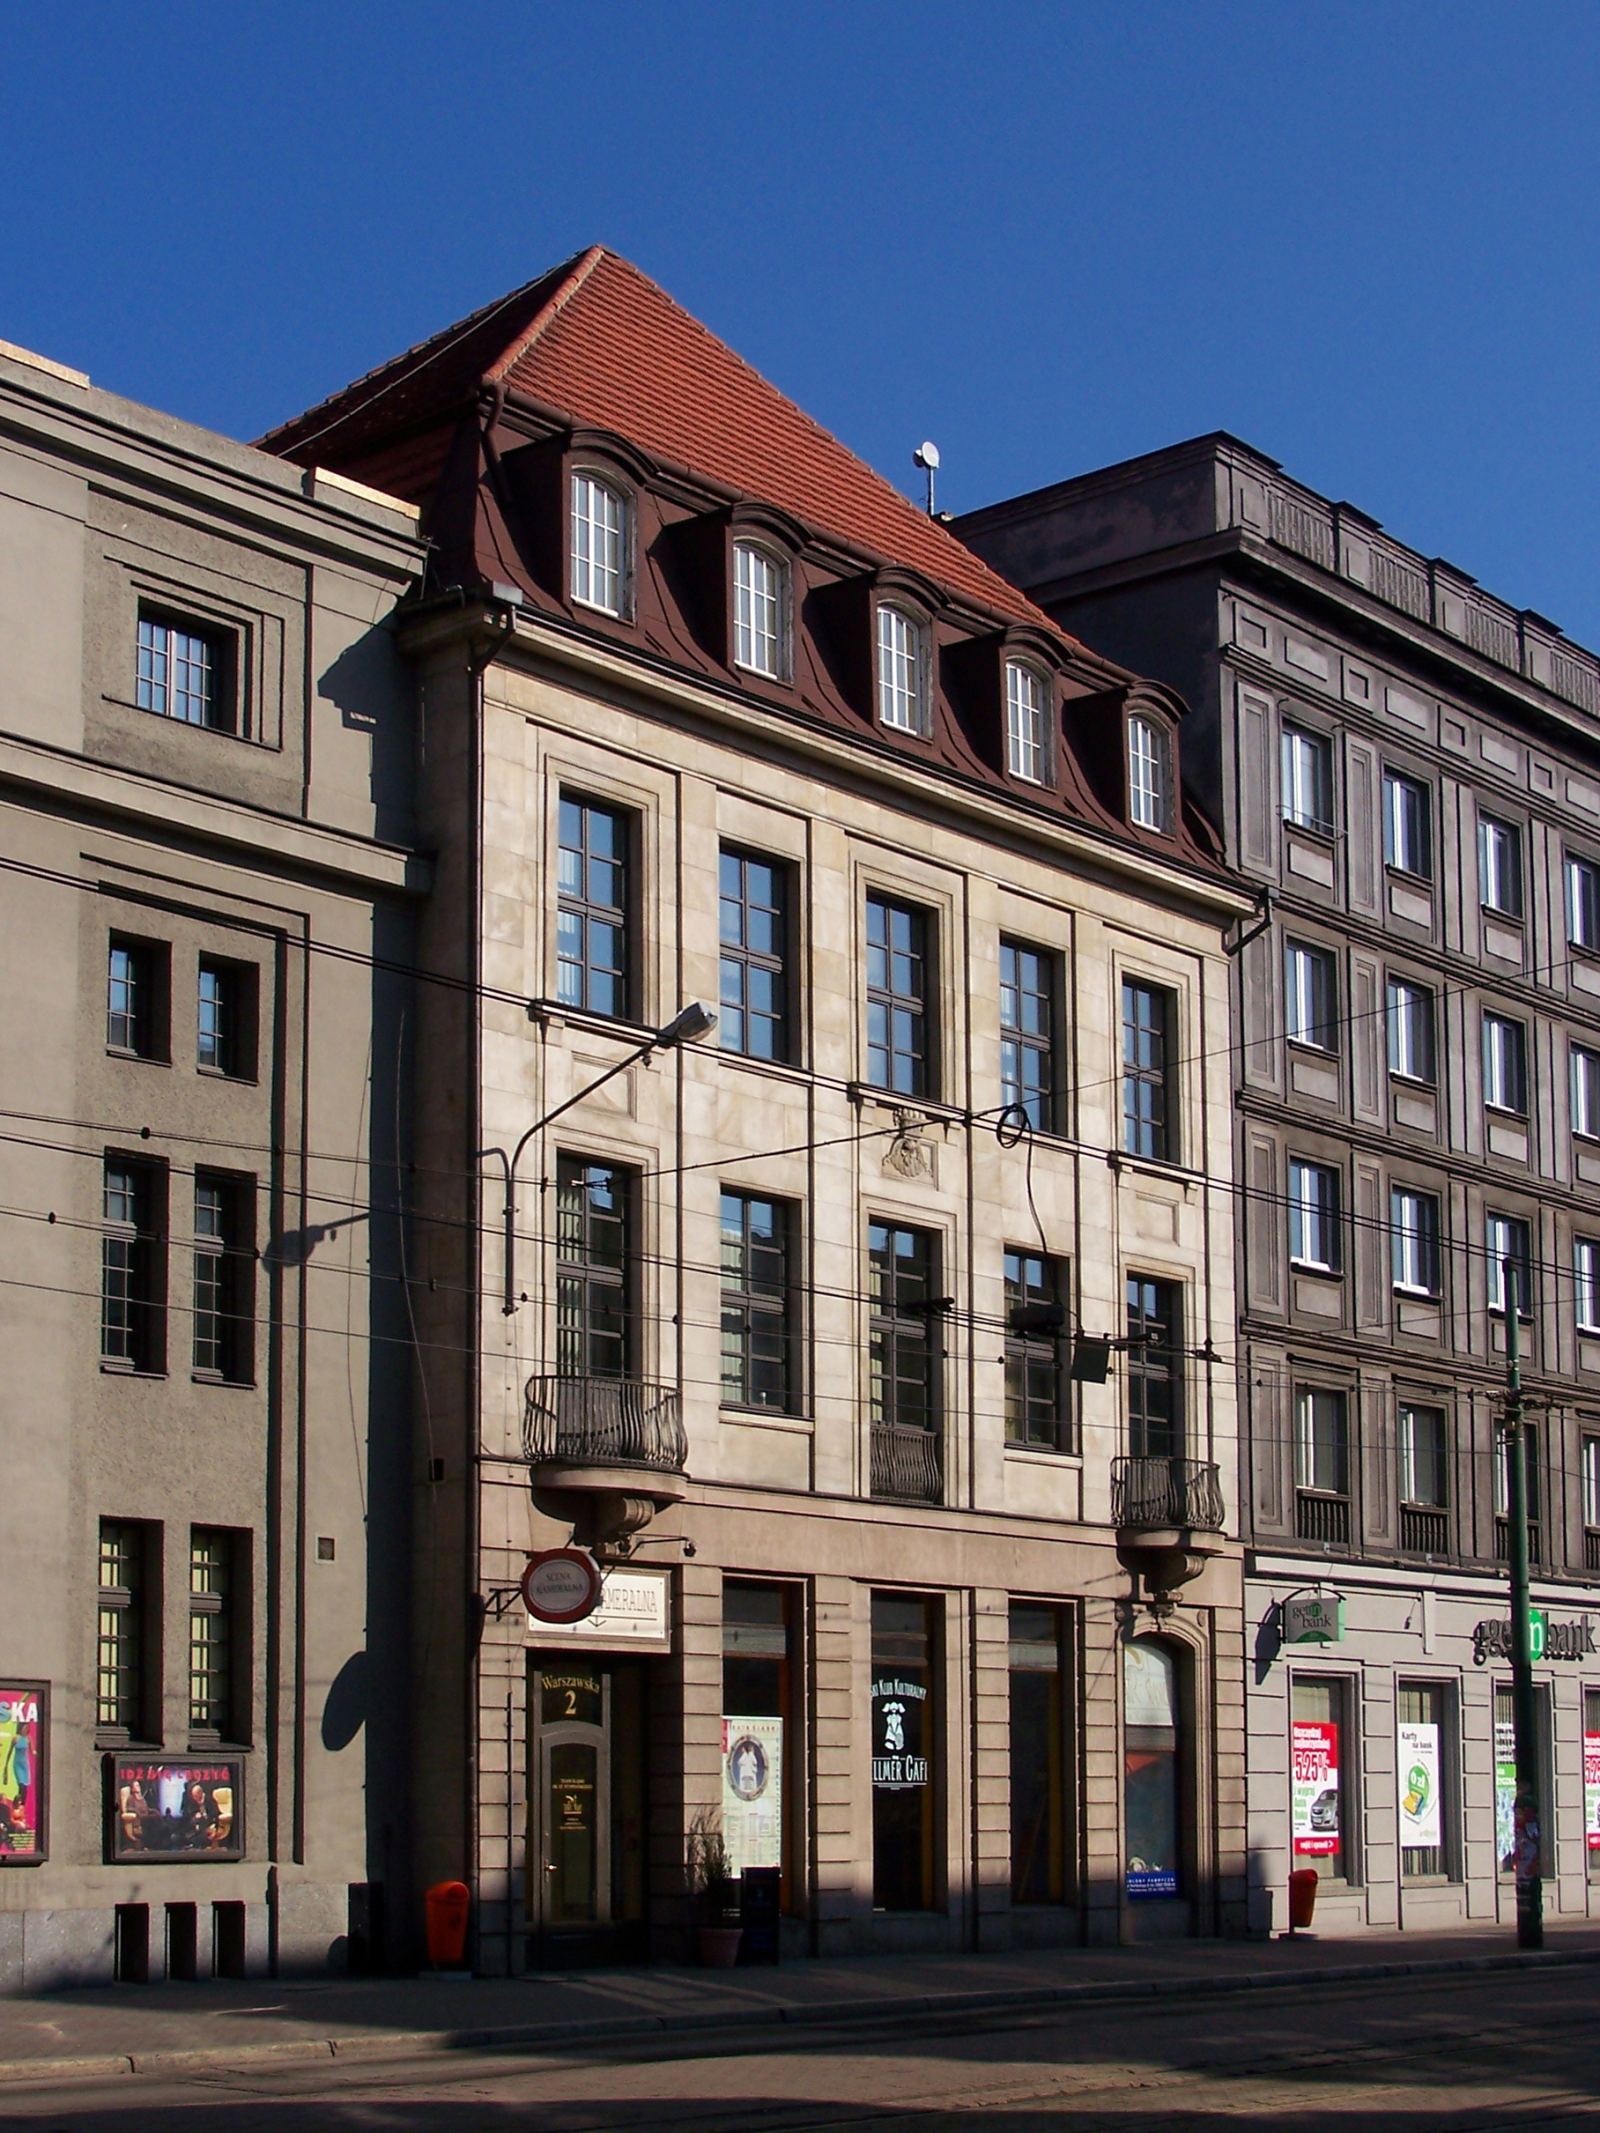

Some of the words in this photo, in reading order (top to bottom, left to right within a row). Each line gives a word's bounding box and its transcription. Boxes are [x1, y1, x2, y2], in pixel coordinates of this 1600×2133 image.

[1302, 1614, 1332, 1628] bank
[1543, 1611, 1597, 1653] bank
[541, 1675, 600, 1694] Warszawska
[565, 1690, 577, 1715] 2
